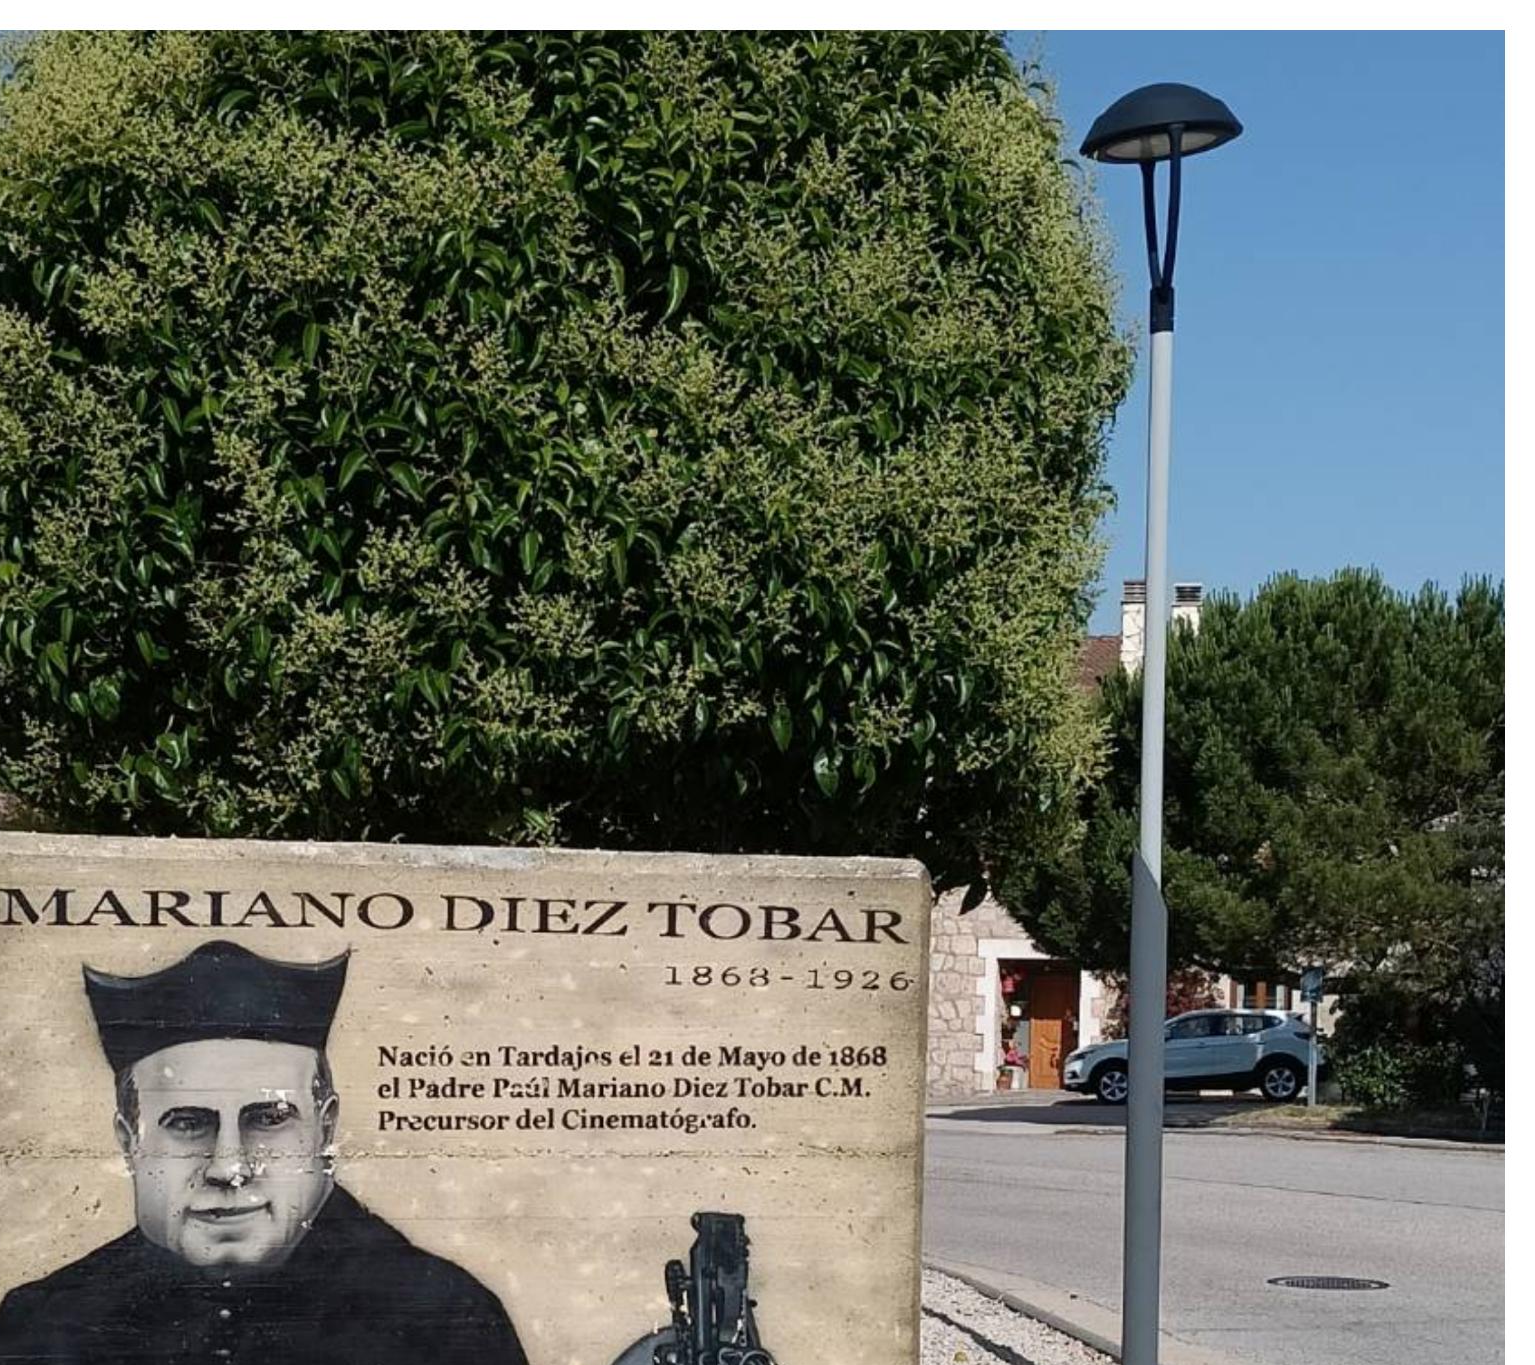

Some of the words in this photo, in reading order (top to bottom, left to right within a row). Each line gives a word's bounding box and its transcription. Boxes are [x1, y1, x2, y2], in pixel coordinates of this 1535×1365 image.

[439, 894, 629, 936] DIEZ
[647, 901, 910, 945] TOBAR
[378, 1045, 453, 1067] Nació
[460, 1050, 491, 1066] en
[498, 1044, 612, 1071] Tardajos
[619, 1045, 640, 1067] el
[648, 1050, 673, 1067] 21
[681, 1046, 712, 1067] de
[718, 1046, 786, 1071] Mayo
[792, 1046, 822, 1067] de
[829, 1046, 887, 1067] 1868
[378, 1077, 400, 1098] el
[408, 1077, 485, 1098] Padre
[493, 1077, 550, 1098] Paúl
[557, 1077, 666, 1098] Mariano
[673, 1077, 728, 1098] Diez
[734, 1077, 809, 1098] Tobar
[815, 1077, 871, 1098] C.M.
[378, 1110, 510, 1131] Precursor
[516, 1108, 555, 1130] del
[562, 1107, 757, 1134] Cinematógrafo.
